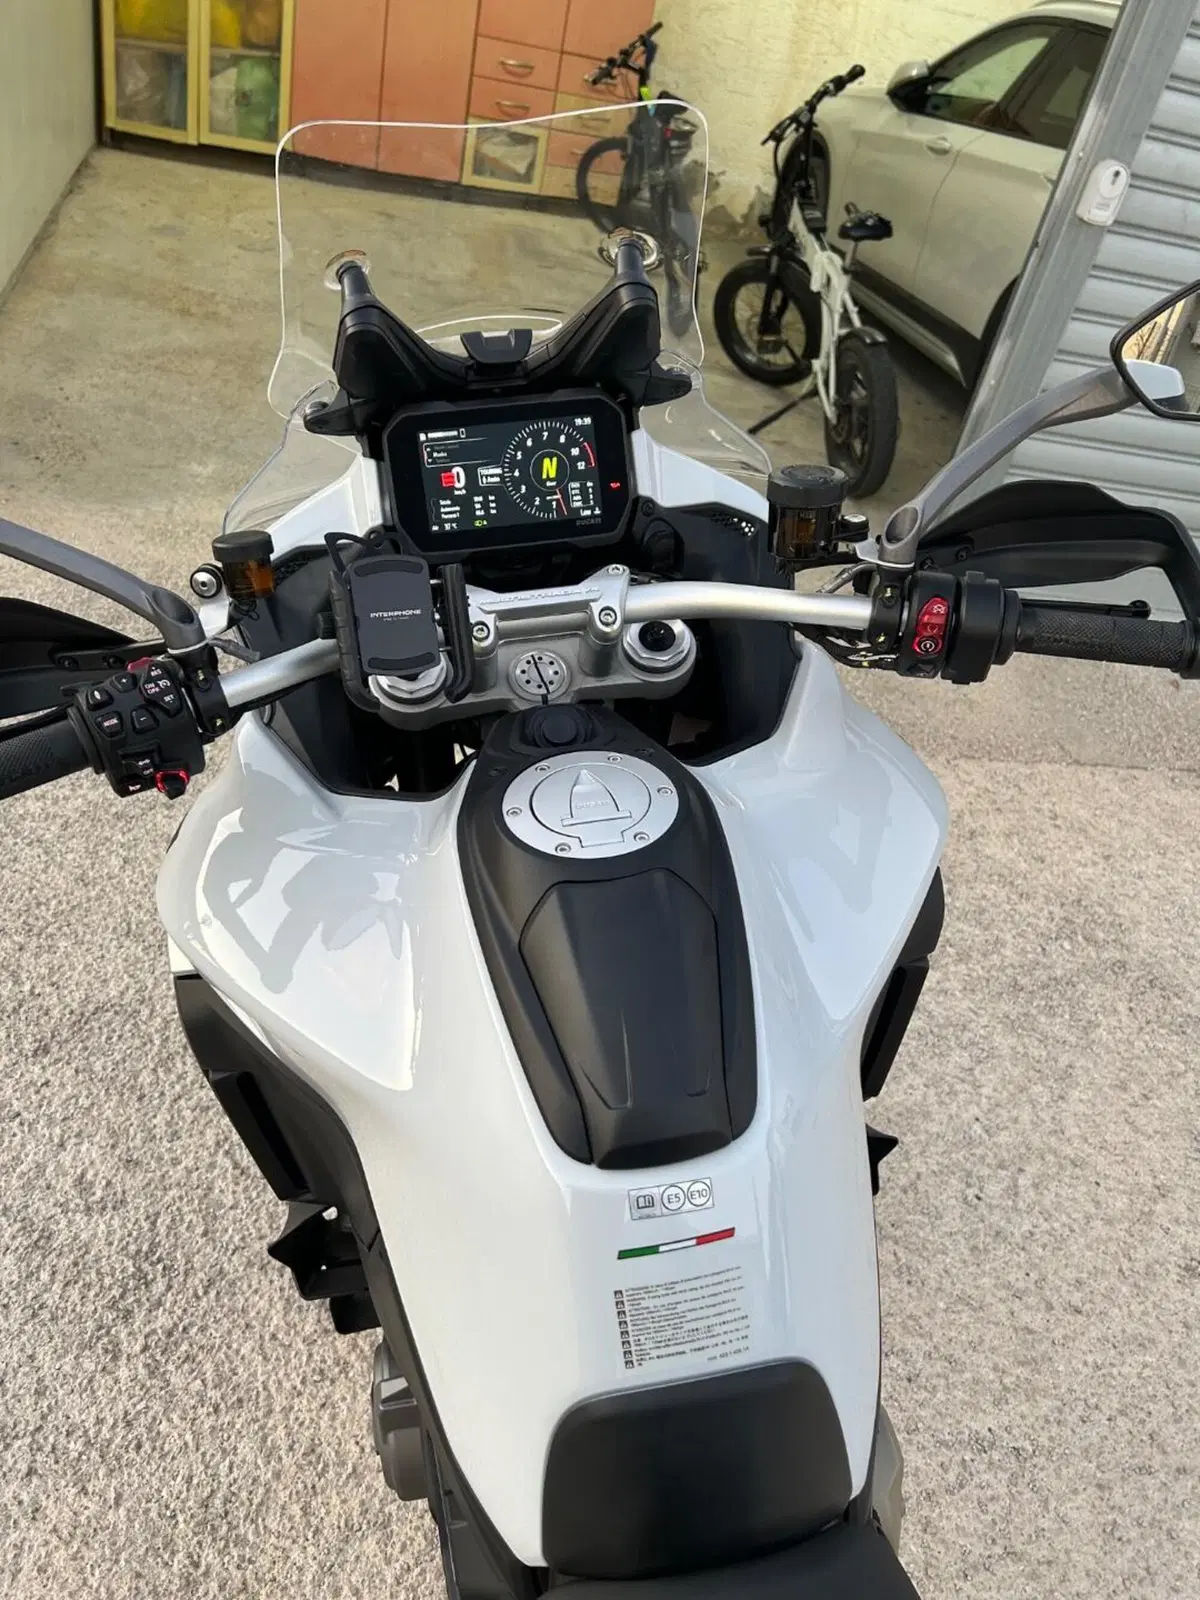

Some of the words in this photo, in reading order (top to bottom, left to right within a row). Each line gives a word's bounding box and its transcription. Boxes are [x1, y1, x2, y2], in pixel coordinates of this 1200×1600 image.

[543, 432, 548, 440] 7
[527, 438, 532, 446] 6
[571, 447, 579, 455] 10
[516, 452, 522, 460] 5
[542, 457, 557, 479] N
[577, 462, 585, 470] 12
[452, 466, 465, 488] 0
[521, 485, 526, 493] 3
[535, 497, 540, 505] 2
[370, 609, 421, 618] INTERPHONE
[667, 1193, 681, 1204] E5
[690, 1189, 707, 1200] E10
